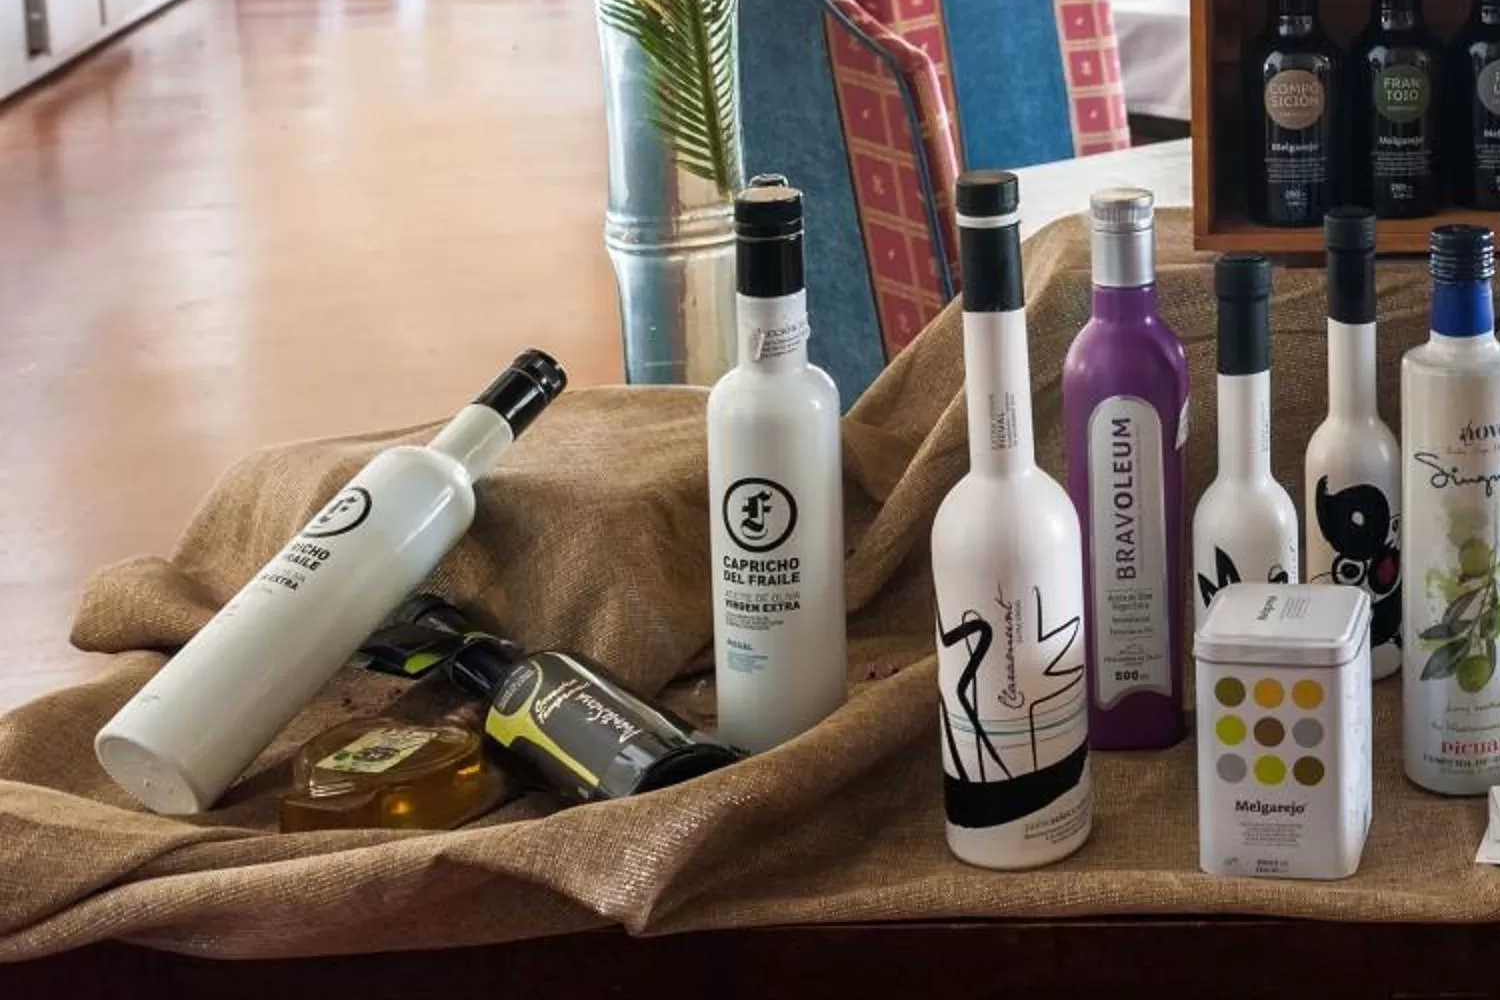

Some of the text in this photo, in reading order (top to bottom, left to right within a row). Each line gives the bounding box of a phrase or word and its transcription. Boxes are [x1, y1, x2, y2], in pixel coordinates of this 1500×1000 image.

[1383, 77, 1420, 89] FRAN
[1112, 417, 1137, 580] BRAVOLEUM
[723, 555, 800, 573] CAPRICHO
[723, 570, 801, 587] DEL FRAILE
[762, 601, 801, 613] EXTRA
[1114, 670, 1139, 681] 500
[1235, 800, 1305, 817] Melgarejo
